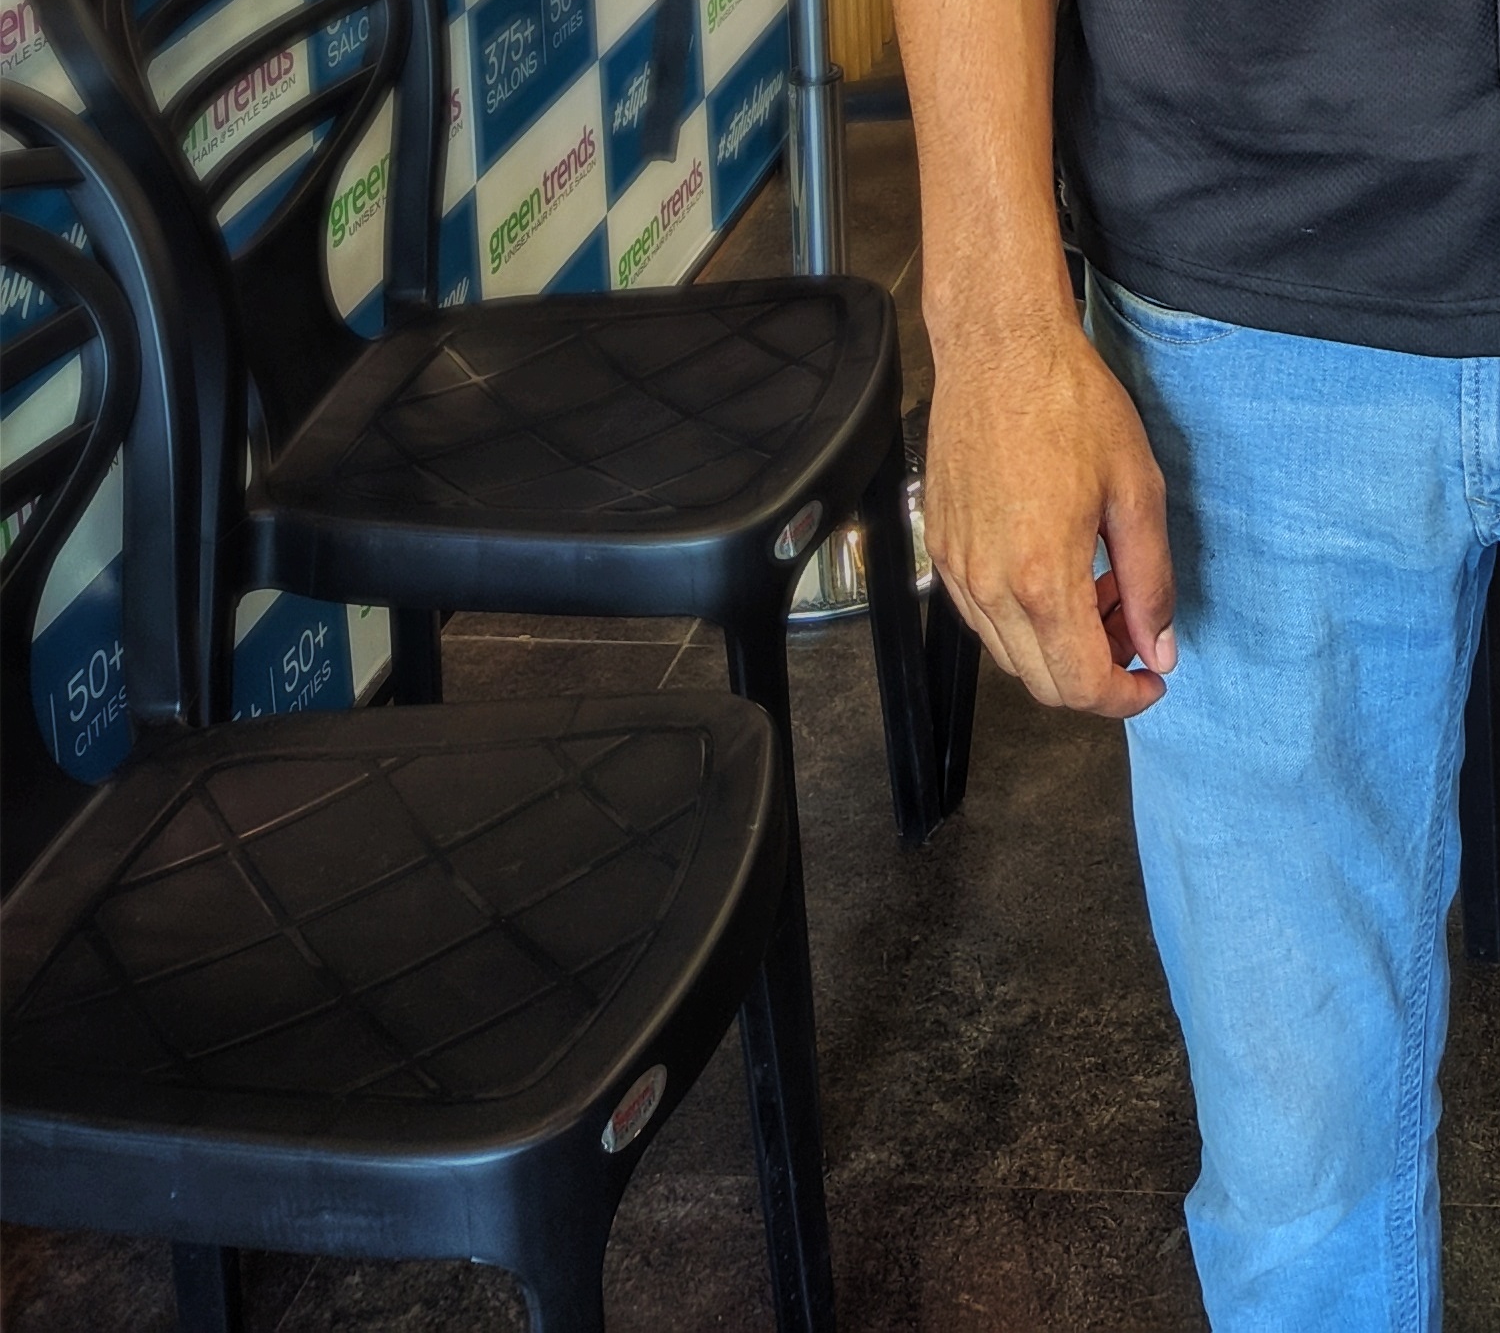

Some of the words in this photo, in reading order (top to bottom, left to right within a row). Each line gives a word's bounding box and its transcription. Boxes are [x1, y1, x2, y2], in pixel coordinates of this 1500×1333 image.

[485, 18, 535, 85] 375+
[553, 10, 583, 49] CITIES
[487, 51, 538, 114] SALONS
[192, 137, 218, 166] HAIR
[228, 104, 261, 138] STYLE
[262, 74, 296, 109] SALON
[348, 202, 381, 236] UNISEX
[489, 187, 542, 275] green
[542, 125, 596, 206] trends
[618, 215, 660, 290] green
[661, 157, 704, 231] trends
[68, 640, 124, 723] 50+
[283, 621, 328, 693] 50+
